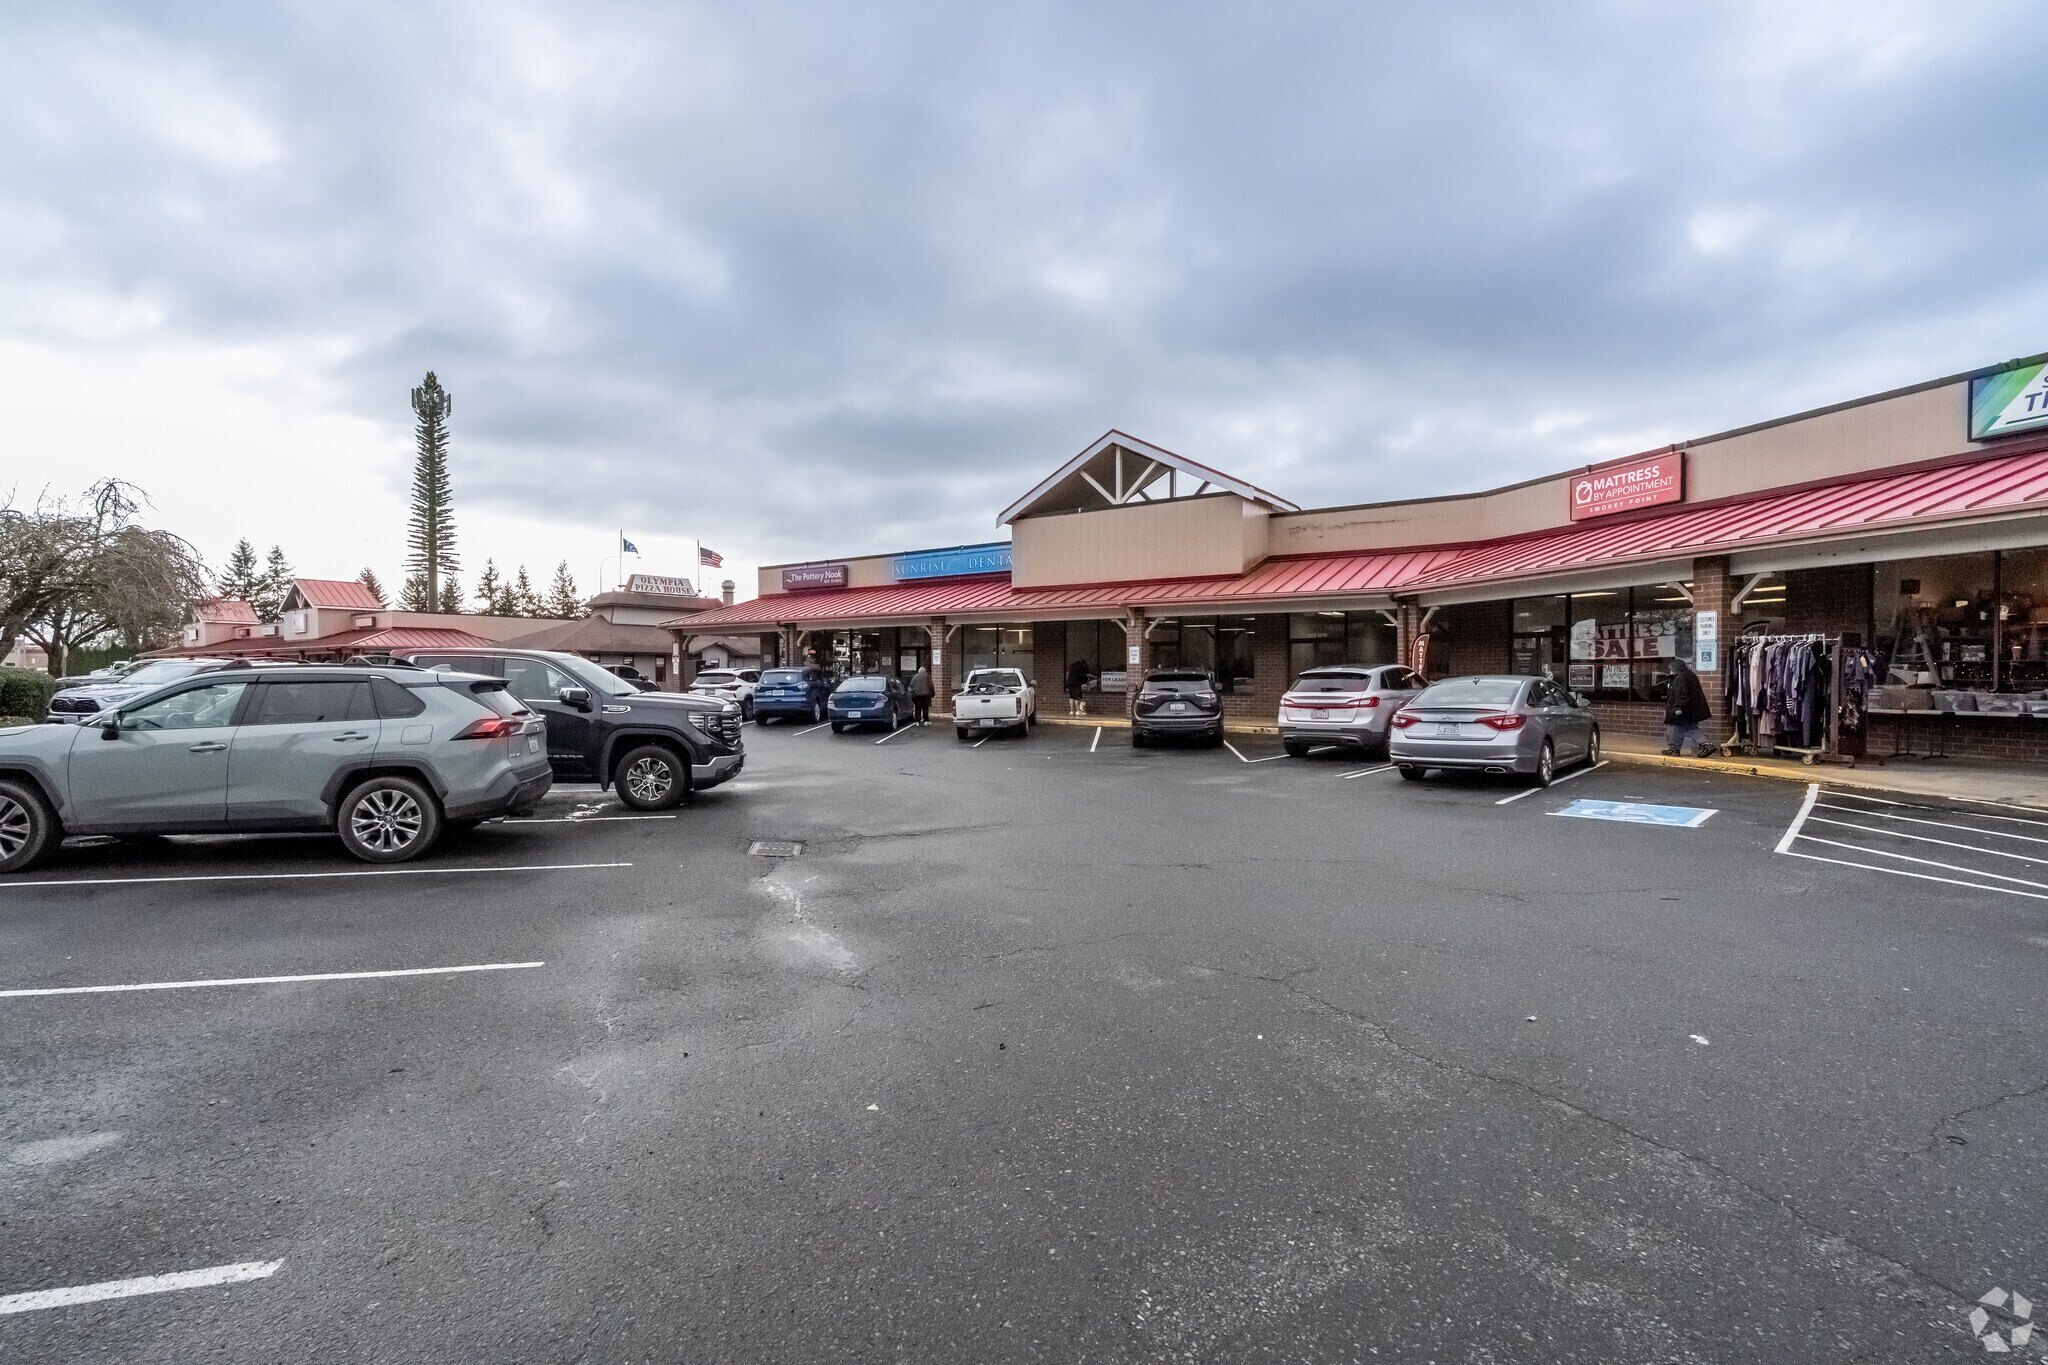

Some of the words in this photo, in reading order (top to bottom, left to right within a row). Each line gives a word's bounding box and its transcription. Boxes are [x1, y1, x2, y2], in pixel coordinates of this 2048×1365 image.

[1593, 465, 1660, 491] MATTRESS
[1593, 491, 1605, 501] BY
[1605, 475, 1674, 499] APPOINTMENT
[1589, 502, 1624, 513] SMOKEY
[1629, 494, 1658, 505] POINT
[895, 560, 947, 576] SUNRISE
[968, 554, 1013, 569] DENTA
[640, 576, 684, 587] OLYMPIA
[790, 573, 802, 582] The
[802, 572, 825, 583] Pottery
[825, 569, 842, 579] Nook
[635, 583, 661, 593] PIZZA
[663, 586, 692, 595] HOUSE
